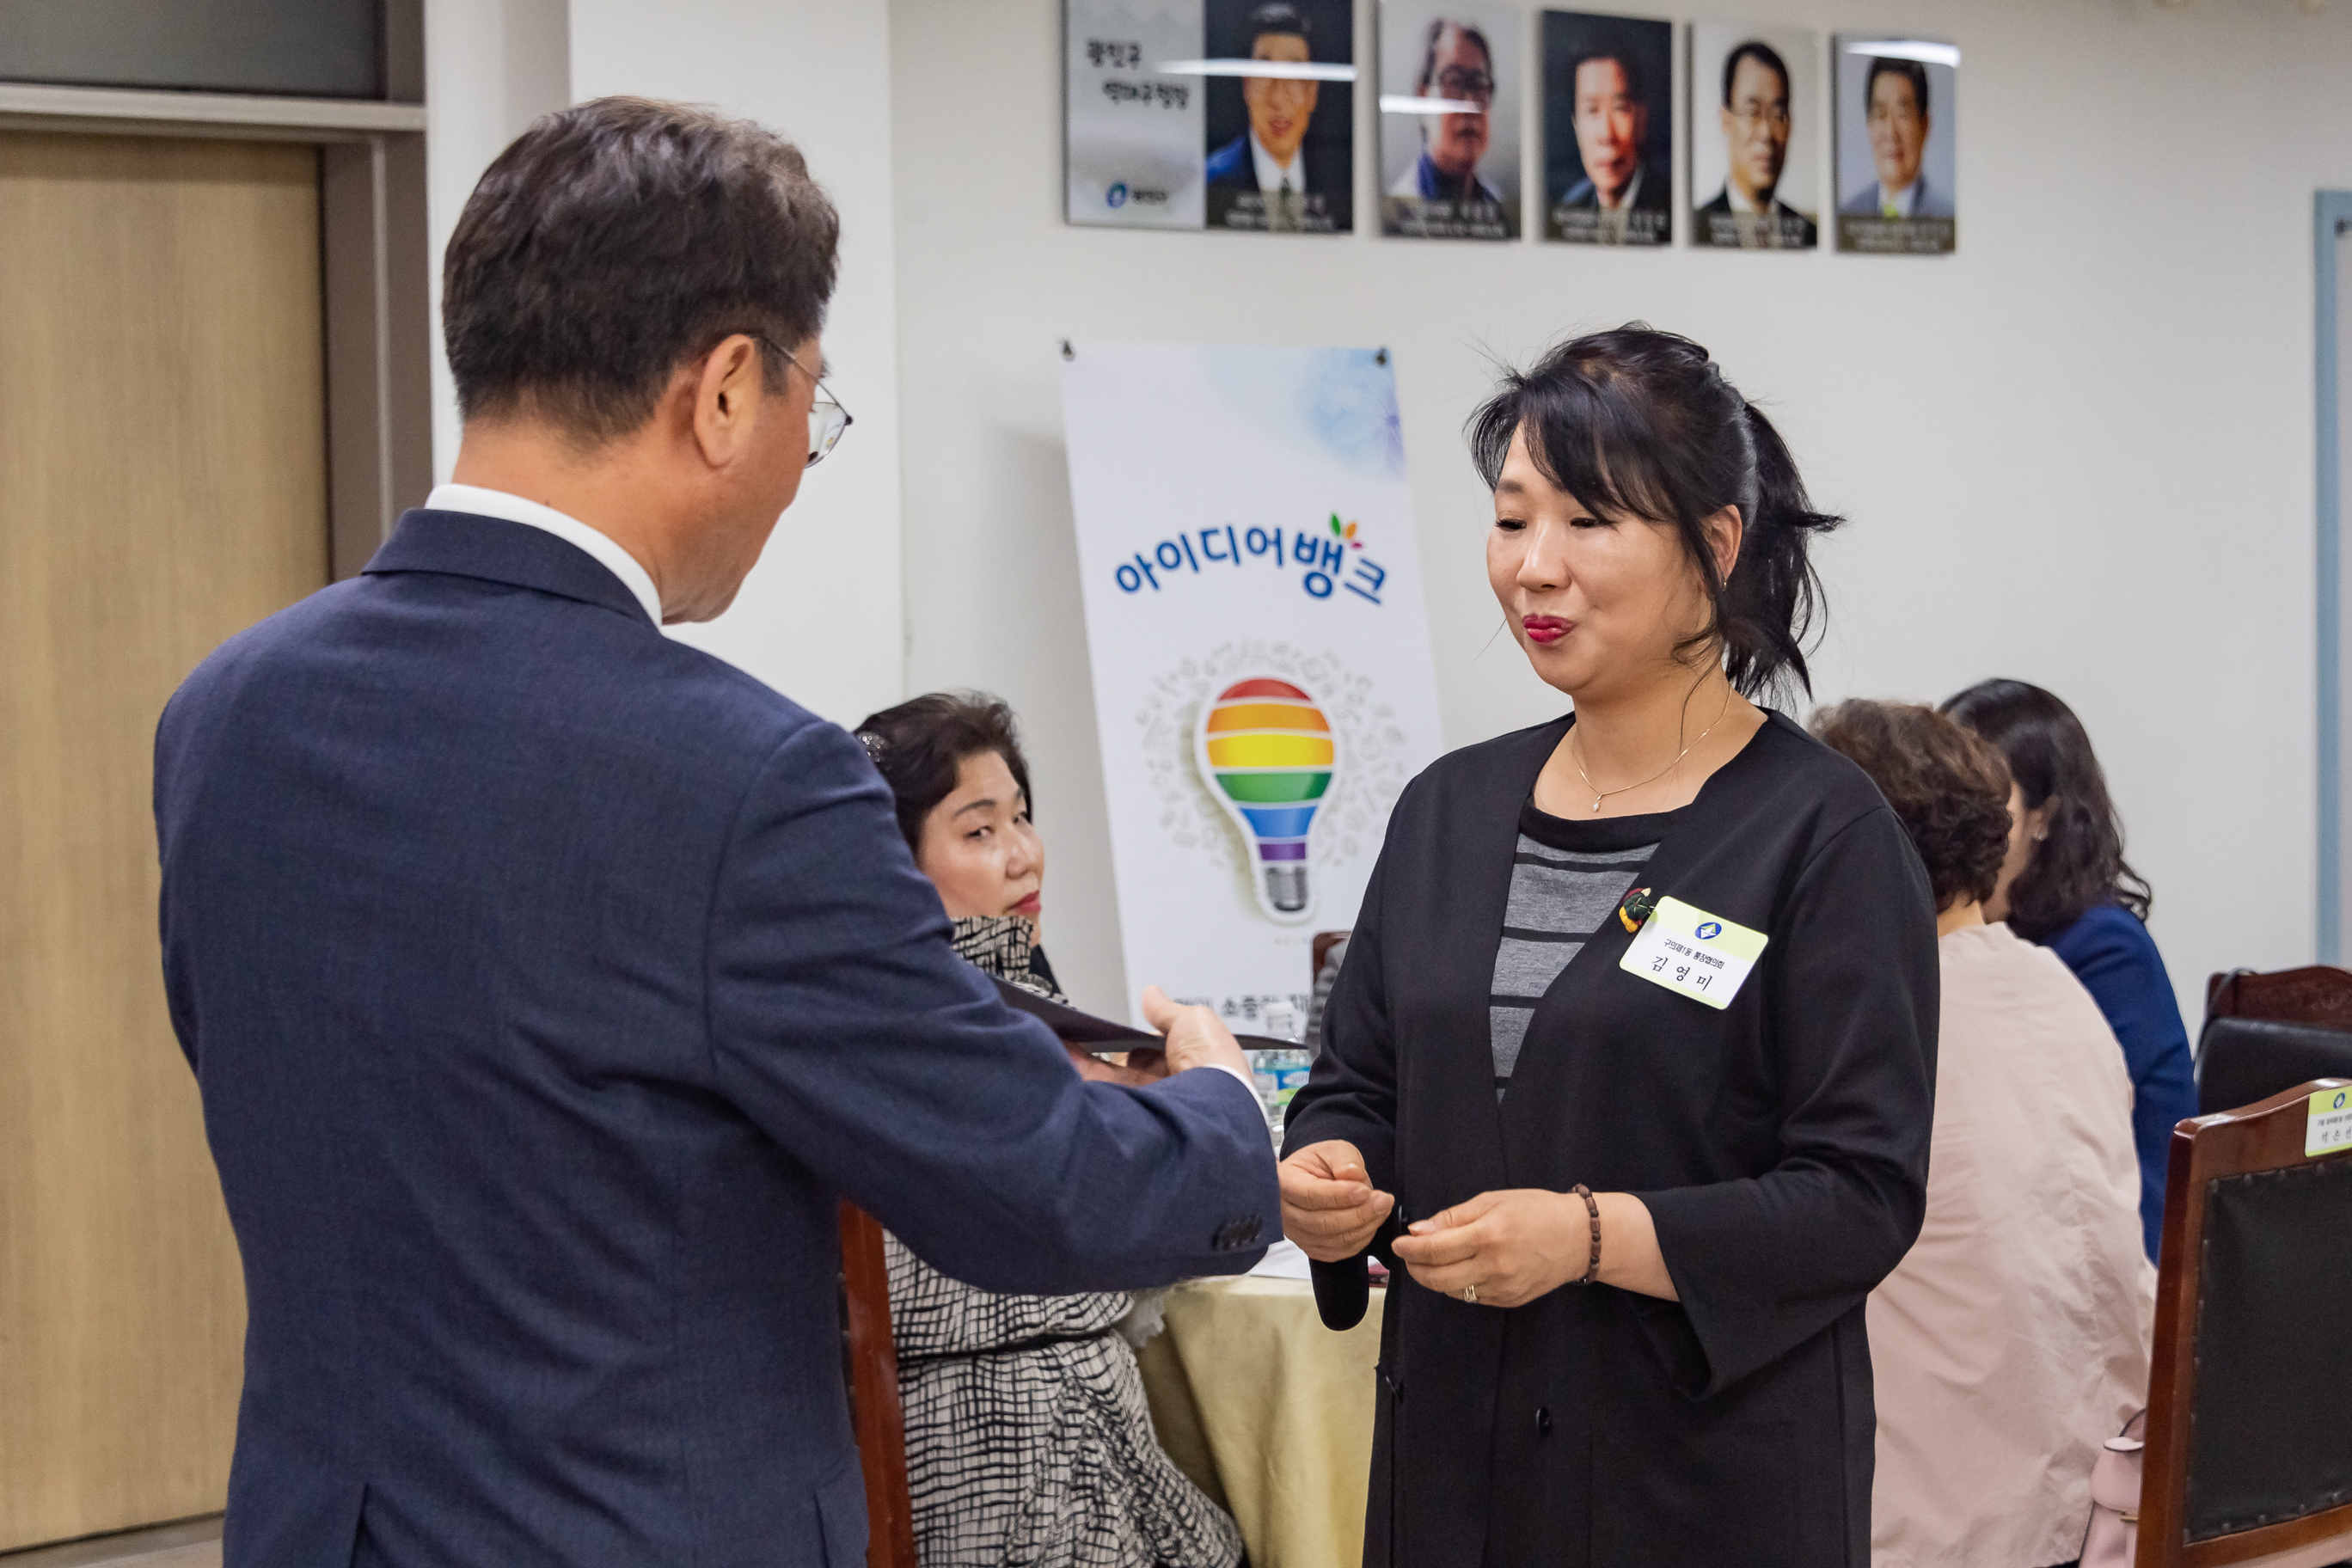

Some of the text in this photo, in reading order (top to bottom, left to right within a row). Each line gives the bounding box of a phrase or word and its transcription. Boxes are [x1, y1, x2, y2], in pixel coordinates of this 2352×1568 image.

[1114, 524, 1387, 606] 아이디어뱅크
[1664, 939, 1724, 969] 구의제1동 통장협의회
